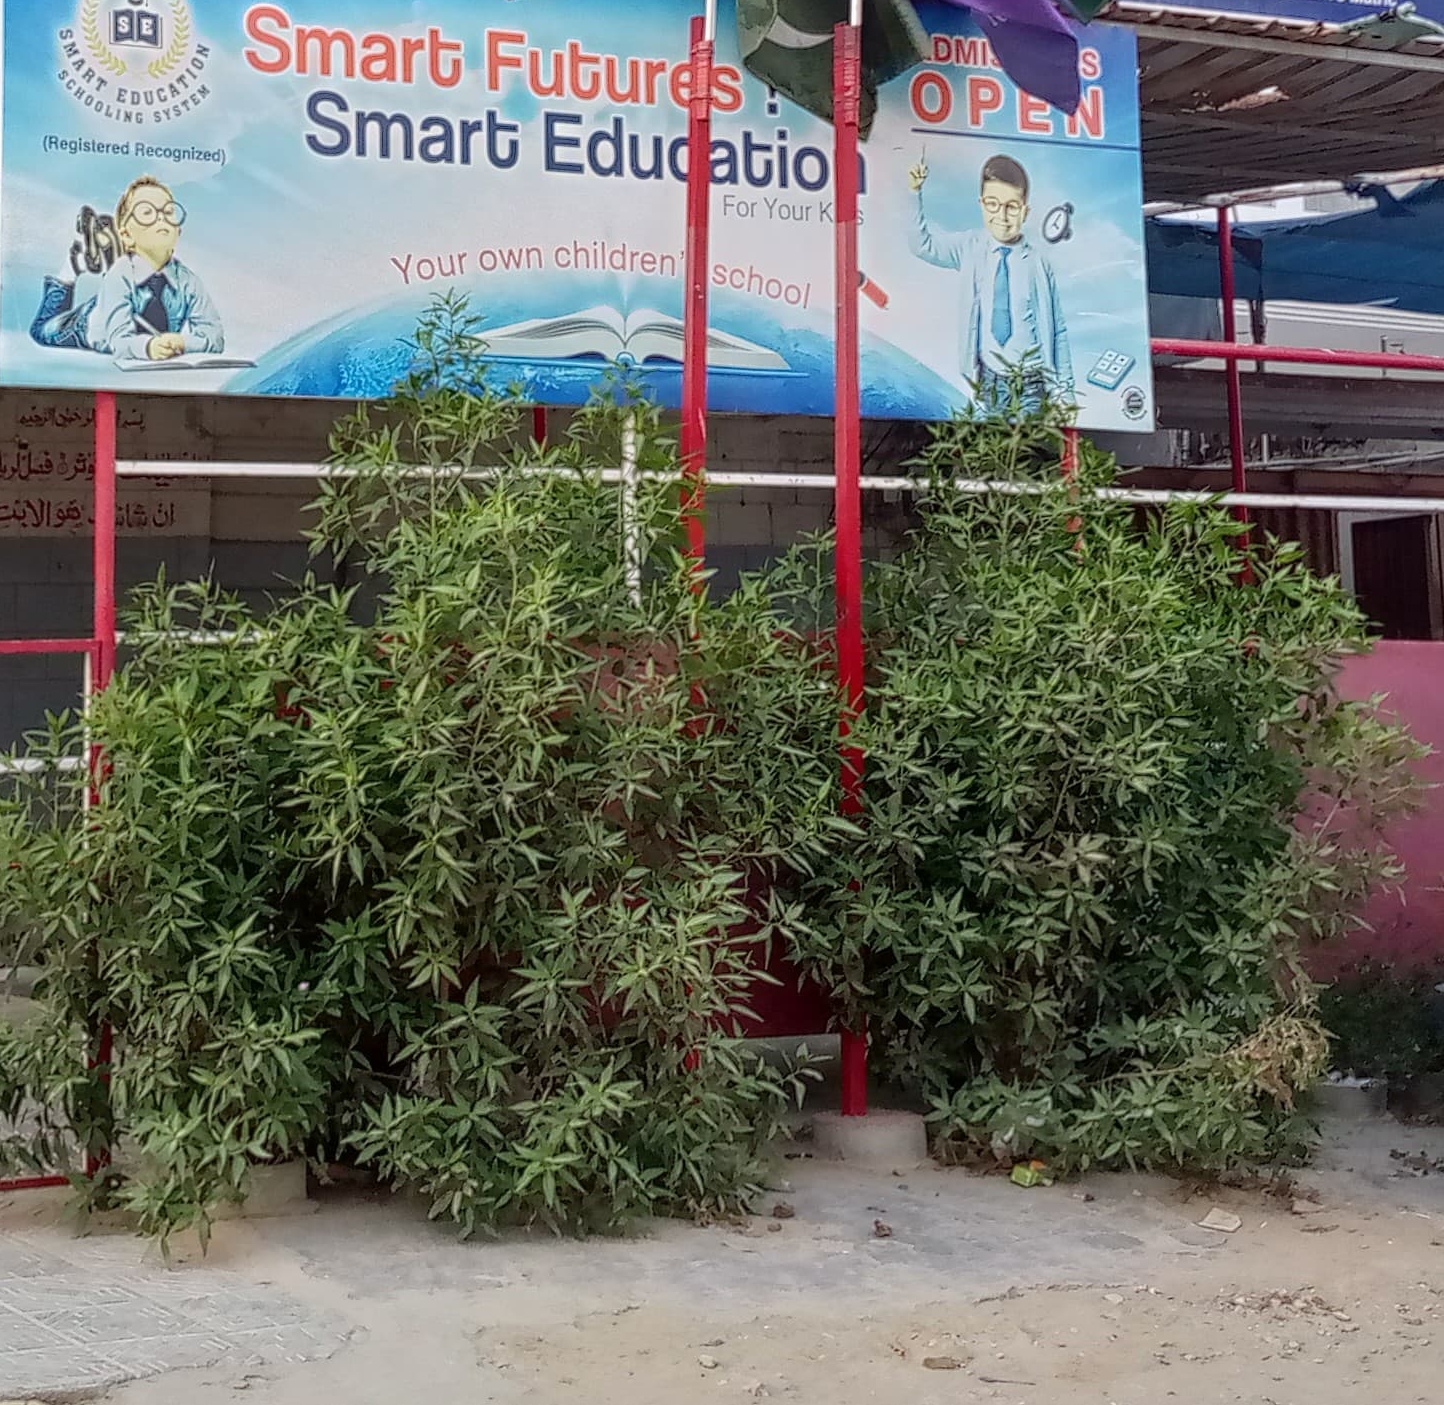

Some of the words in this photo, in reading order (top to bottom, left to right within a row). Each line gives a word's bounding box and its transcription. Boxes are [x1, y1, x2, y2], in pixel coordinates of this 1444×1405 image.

[59, 28, 108, 93] SMART
[116, 43, 211, 106] EDUCATION
[243, 4, 463, 90] Smart
[58, 69, 144, 124] SCHOOLING
[154, 83, 211, 124] SYSTEM
[911, 71, 1103, 136] OPEN
[42, 135, 129, 156] (Registered
[135, 142, 227, 166] Recognized)
[304, 91, 520, 170] Smart
[723, 195, 757, 218] For
[764, 197, 812, 222] Your
[390, 251, 467, 285] Your
[478, 245, 543, 273] own
[712, 263, 811, 309] school
